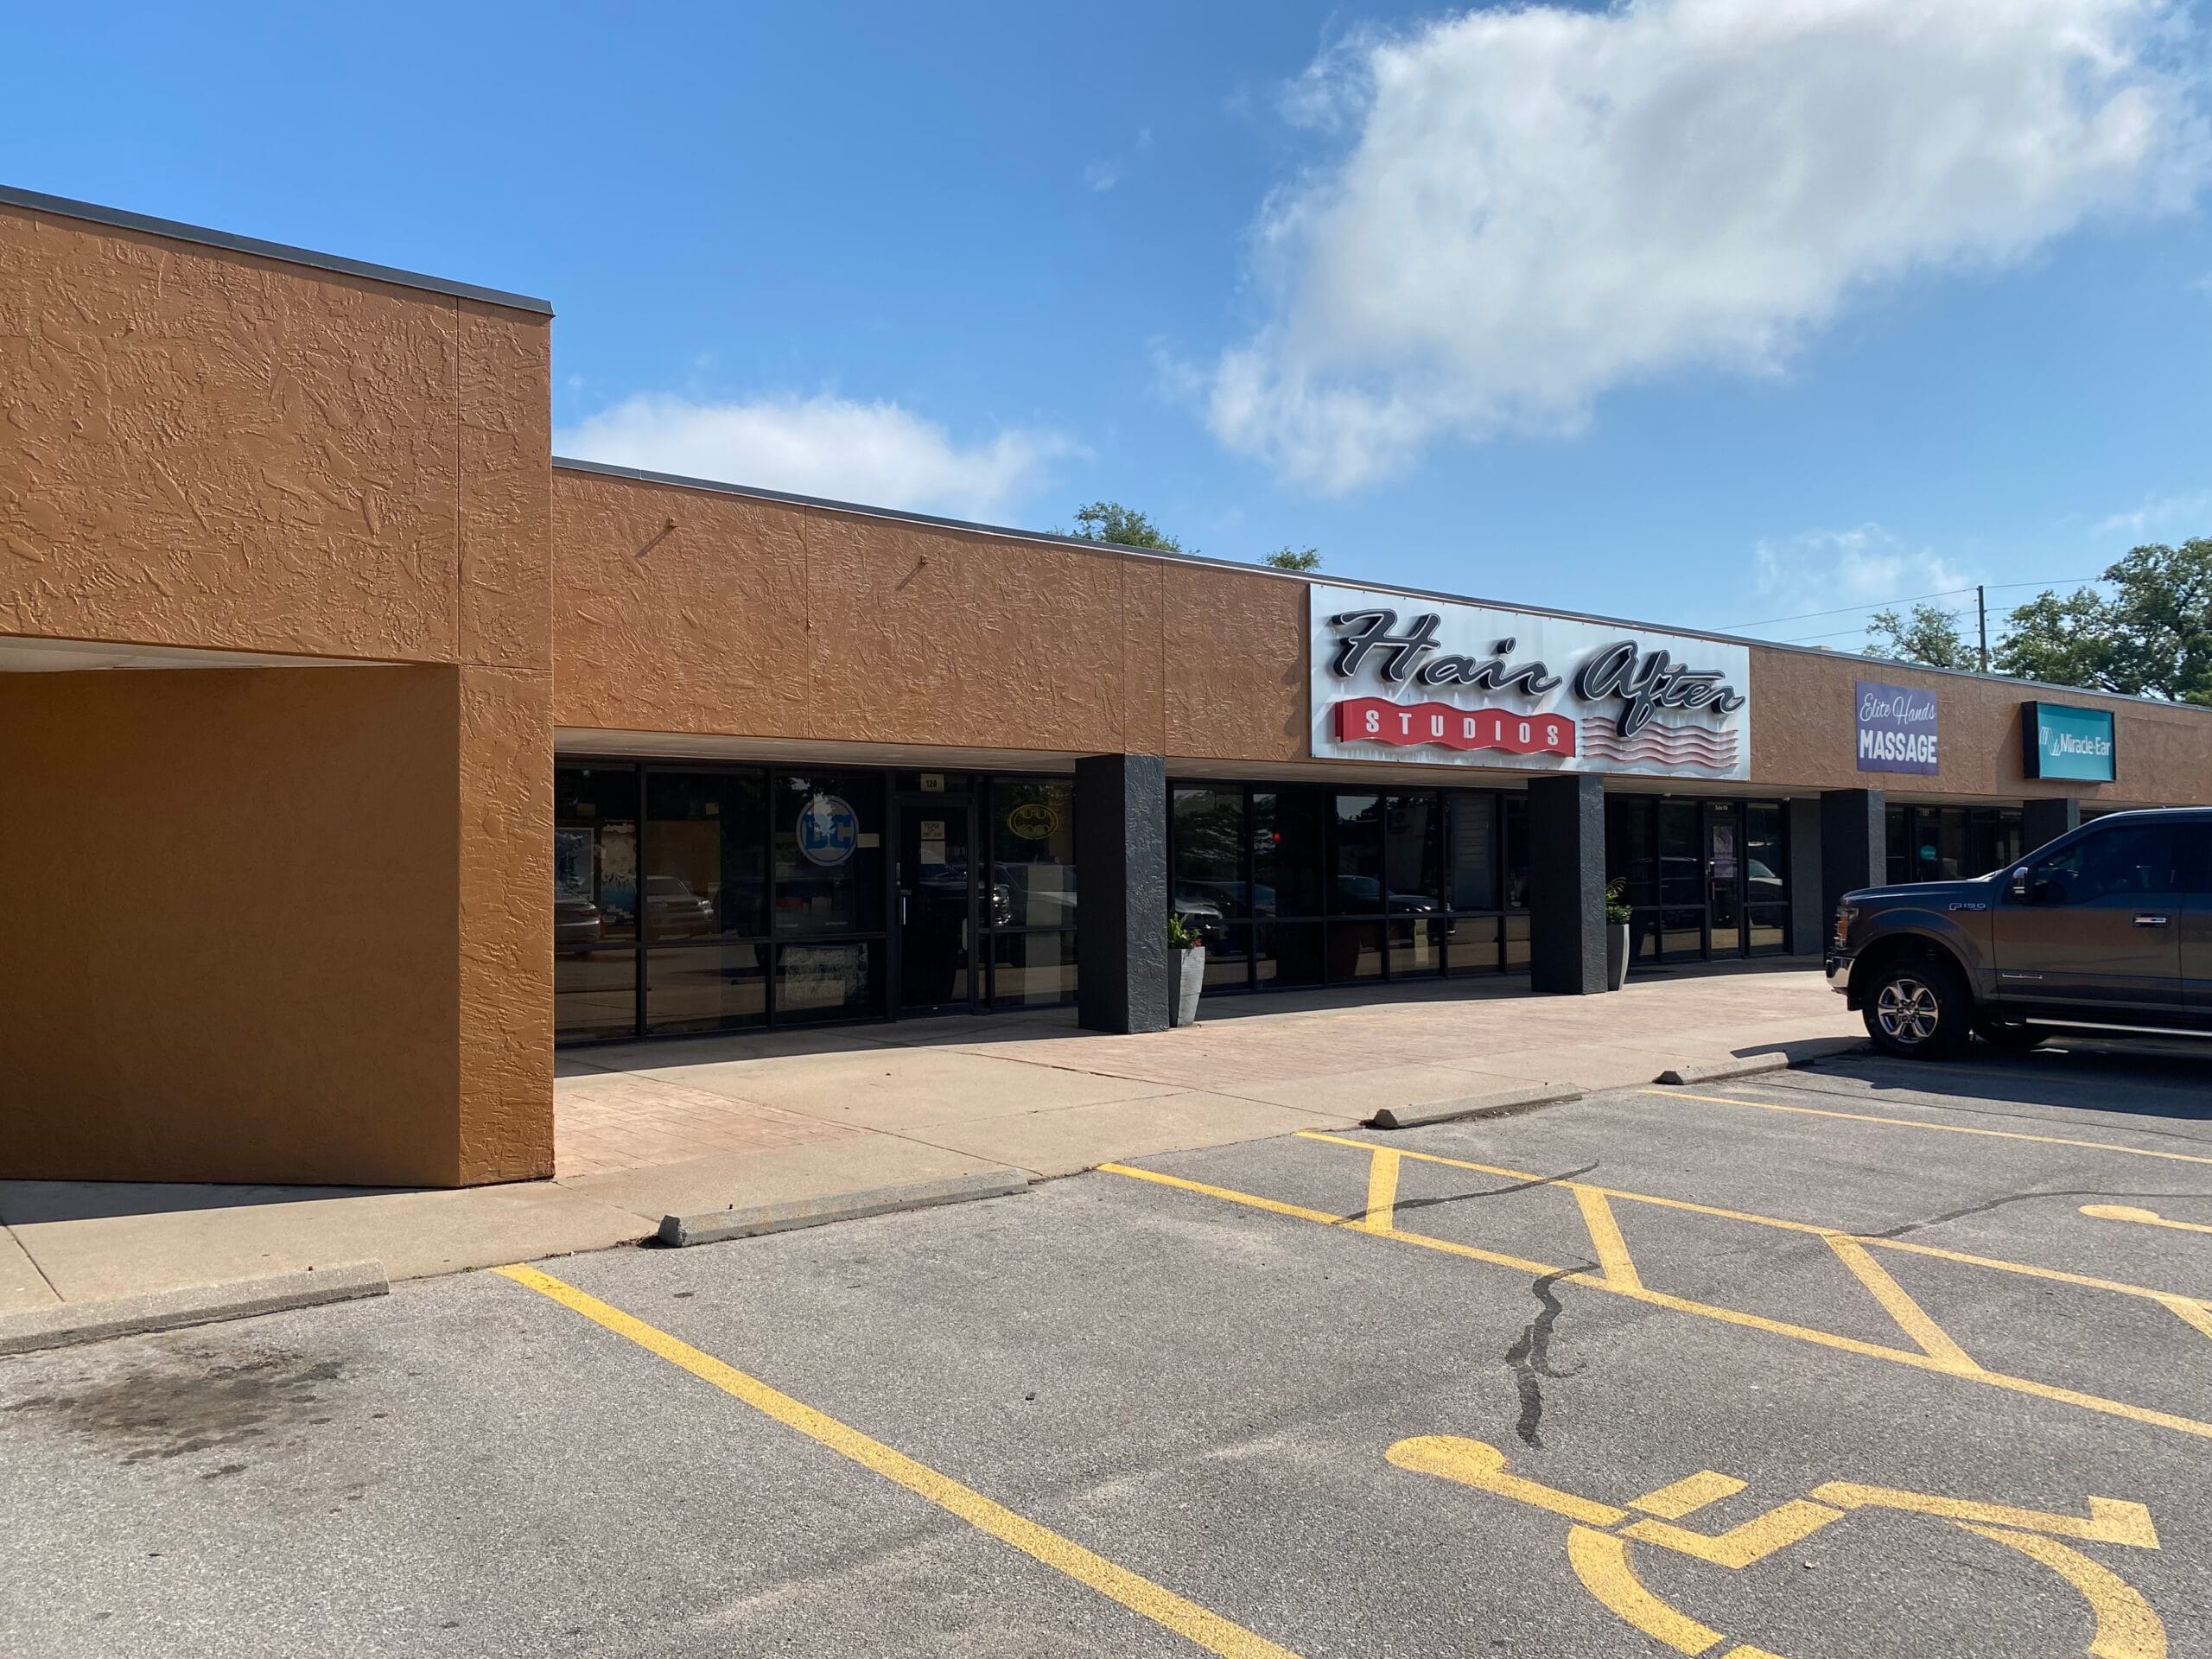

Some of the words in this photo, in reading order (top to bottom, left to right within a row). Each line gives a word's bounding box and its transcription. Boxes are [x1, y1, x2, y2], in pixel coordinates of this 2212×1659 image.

[1332, 608, 1562, 696] Hair
[1574, 639, 1746, 738] After
[1859, 693, 1891, 721] Elite
[1892, 695, 1936, 725] Hands
[1365, 709, 1560, 747] STUDIOS
[2060, 733, 2112, 756] Miracle-Ear
[1859, 729, 1937, 764] MASSAGE
[801, 813, 853, 850] DC
